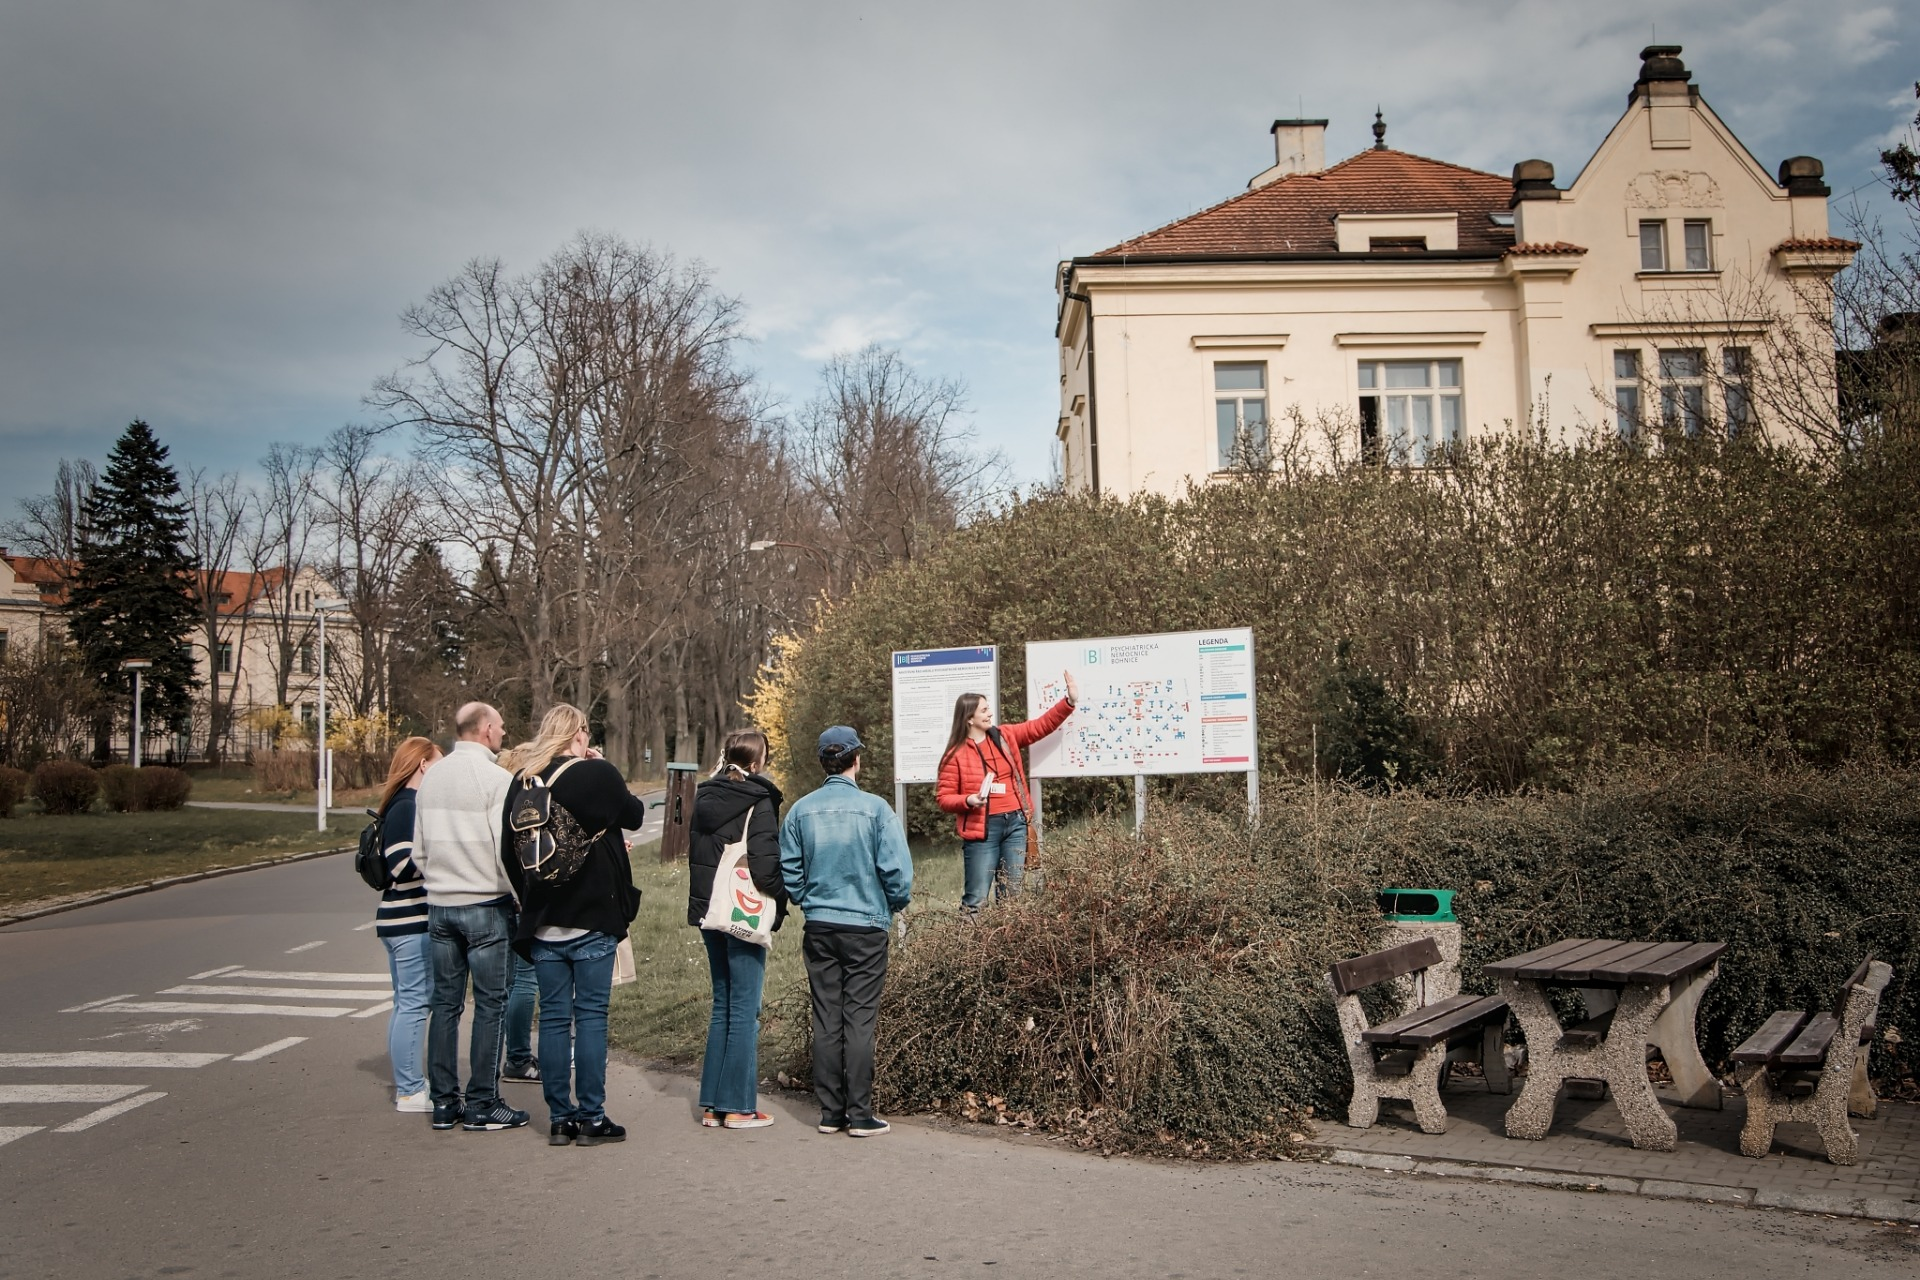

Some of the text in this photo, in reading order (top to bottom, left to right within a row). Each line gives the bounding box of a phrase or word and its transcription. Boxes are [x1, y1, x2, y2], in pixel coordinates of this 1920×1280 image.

[1198, 638, 1229, 646] LEGENDA
[1111, 650, 1148, 658] NEMOCNICE
[729, 928, 752, 938] TIGER
[730, 924, 753, 935] FLYING
